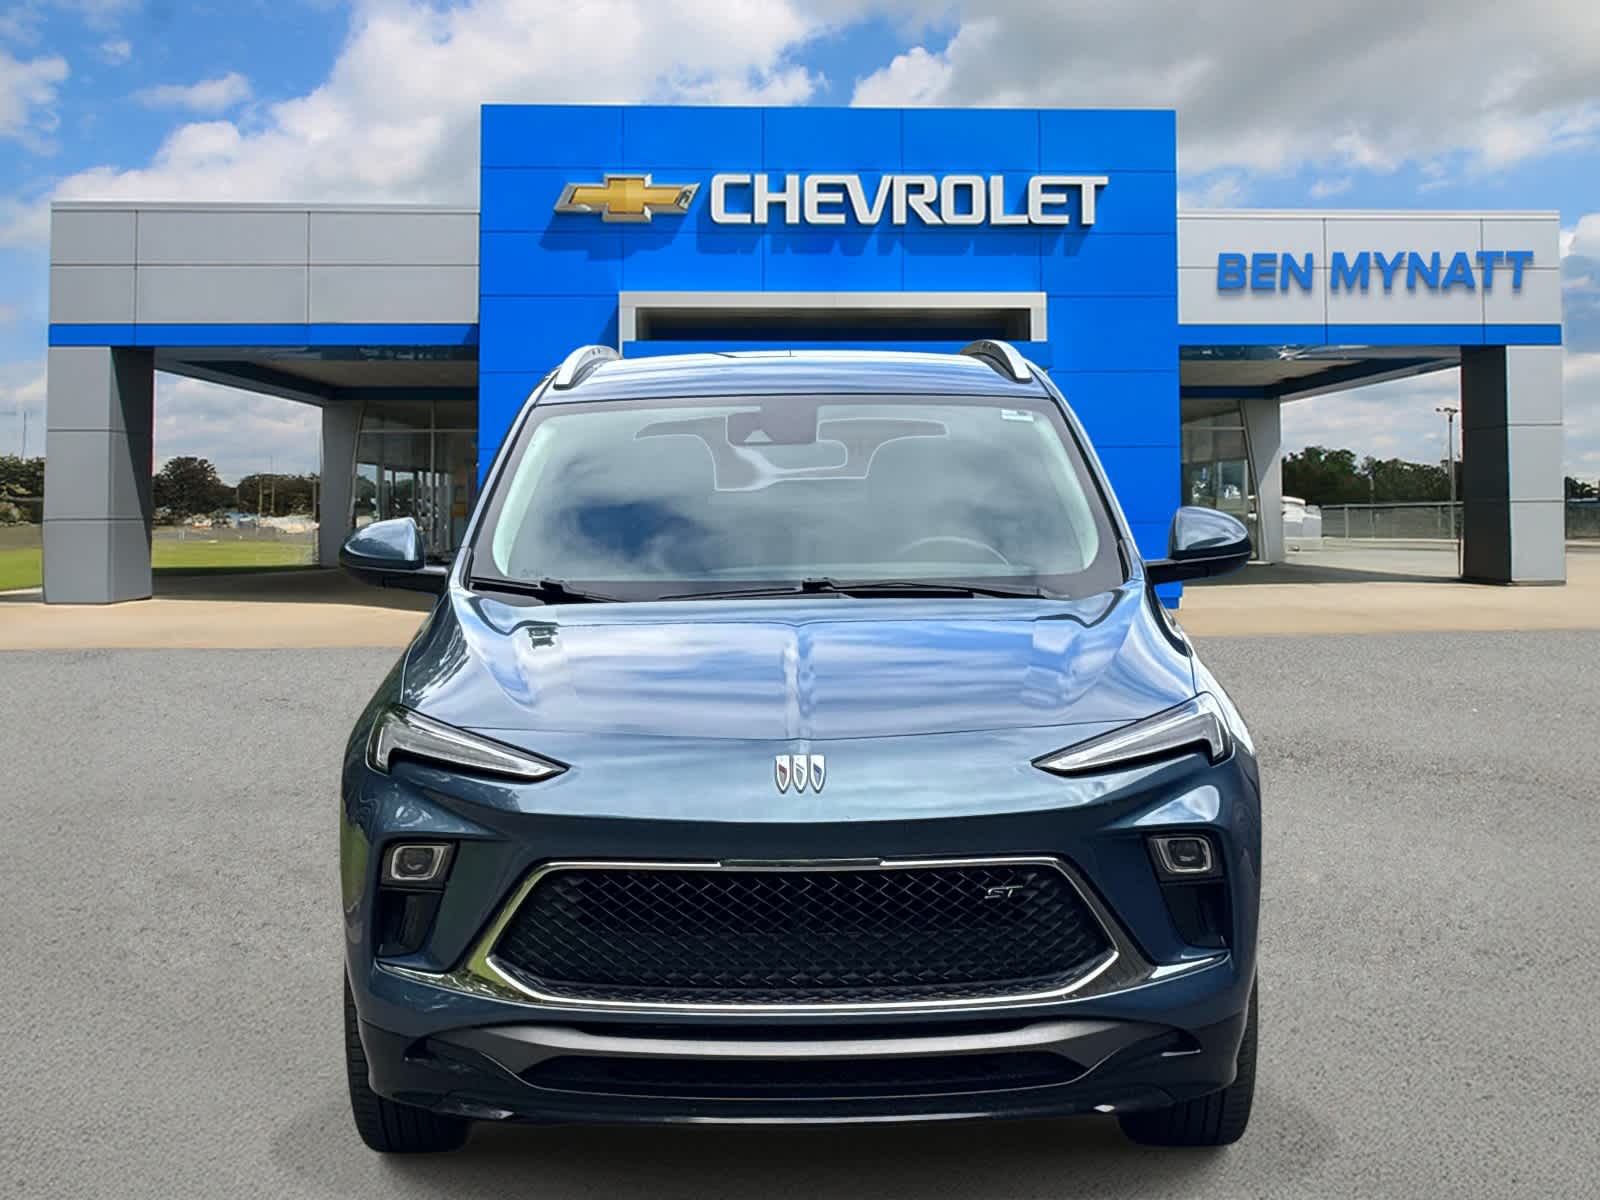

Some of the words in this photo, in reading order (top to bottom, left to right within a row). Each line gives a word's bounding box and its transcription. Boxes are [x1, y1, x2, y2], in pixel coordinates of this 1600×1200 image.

[710, 173, 1109, 225] CHEVROLET
[1217, 252, 1314, 290] BEN
[1330, 251, 1534, 290] MYNATT
[984, 885, 1023, 899] ST
